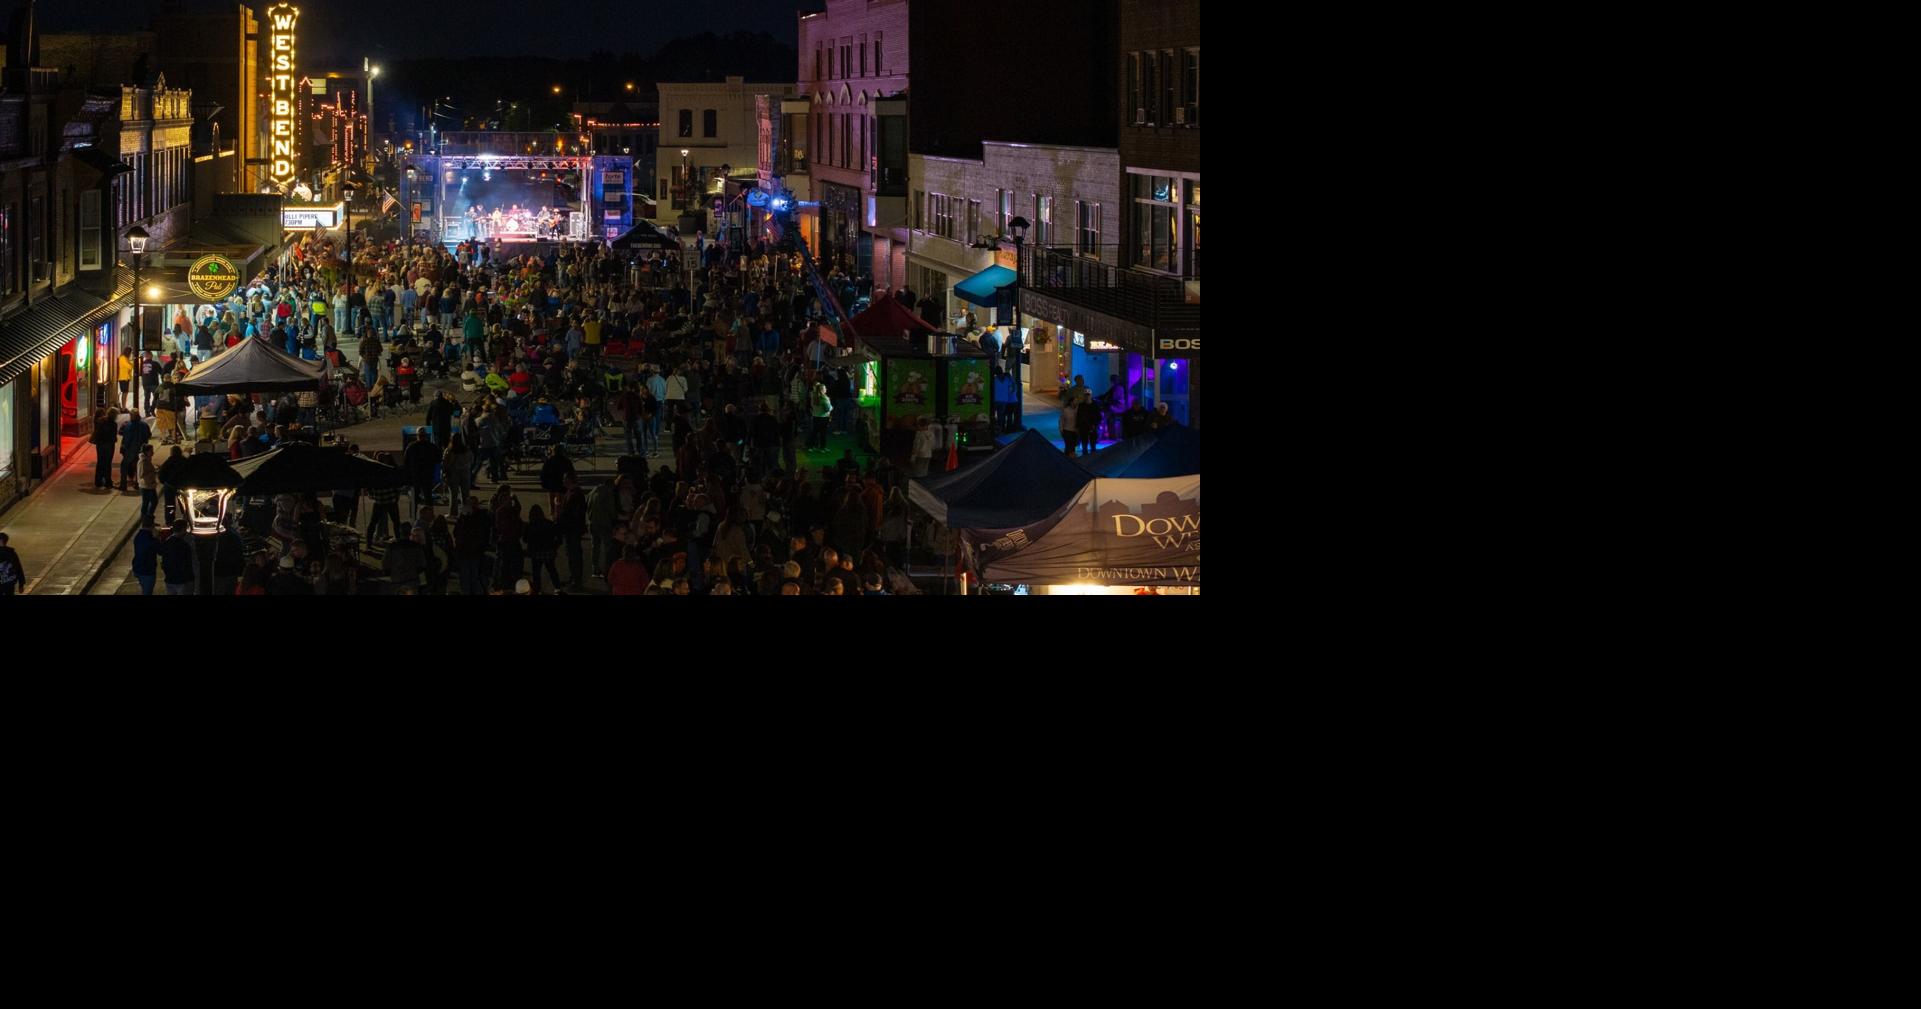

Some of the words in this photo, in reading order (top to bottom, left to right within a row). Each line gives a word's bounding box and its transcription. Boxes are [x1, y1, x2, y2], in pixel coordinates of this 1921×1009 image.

[274, 14, 292, 91] WEST
[275, 101, 290, 176] BEND
[204, 281, 223, 291] Pub
[1024, 292, 1049, 318] BOSS
[1078, 567, 1167, 579] DOWNTOWN
